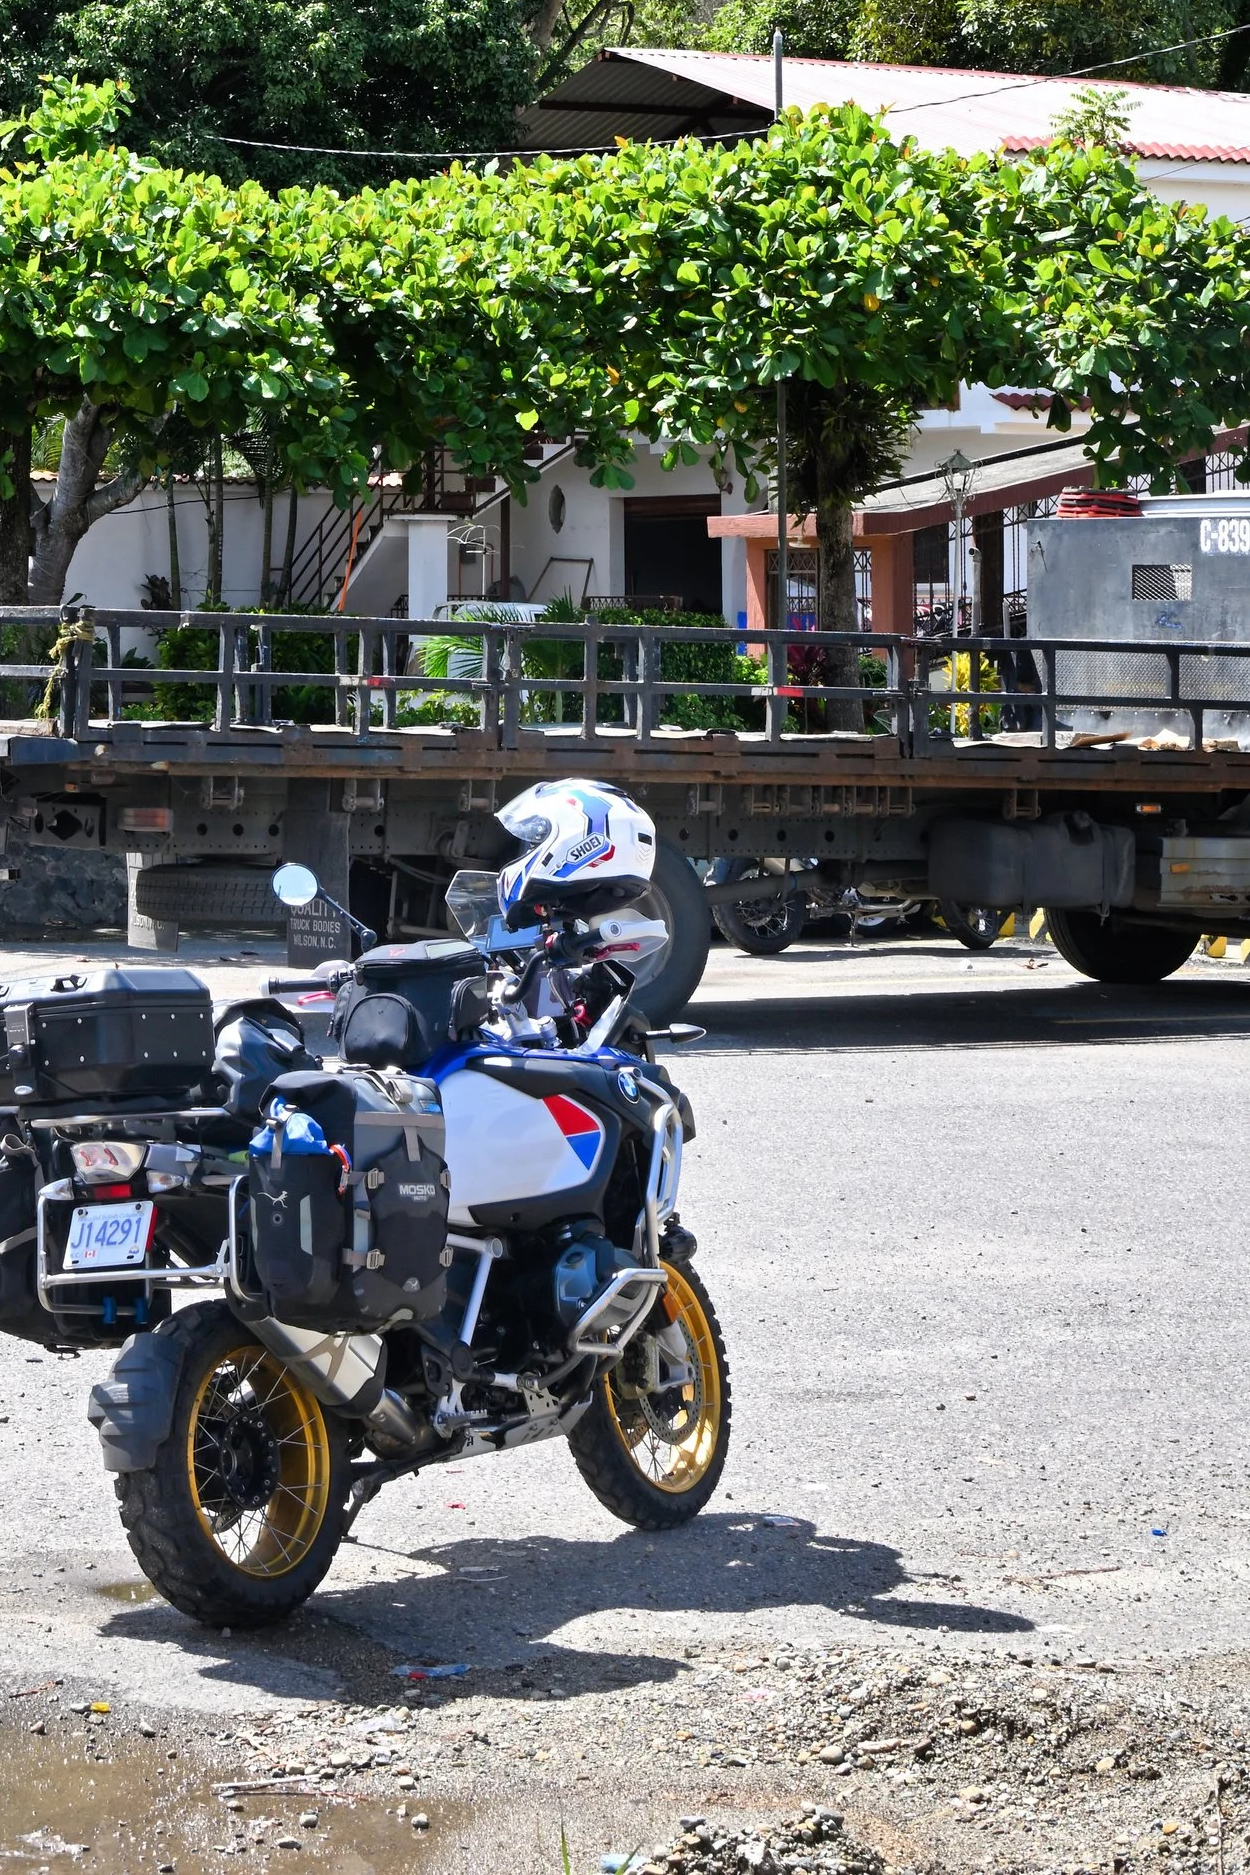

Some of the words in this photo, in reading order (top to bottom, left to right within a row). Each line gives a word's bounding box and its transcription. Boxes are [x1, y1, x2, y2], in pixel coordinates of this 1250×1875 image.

[570, 836, 601, 860] SHOEI
[290, 918, 310, 930] TRUCK
[313, 920, 340, 933] BODIES
[399, 1184, 436, 1195] MOSKO
[71, 1217, 141, 1248] J14291
